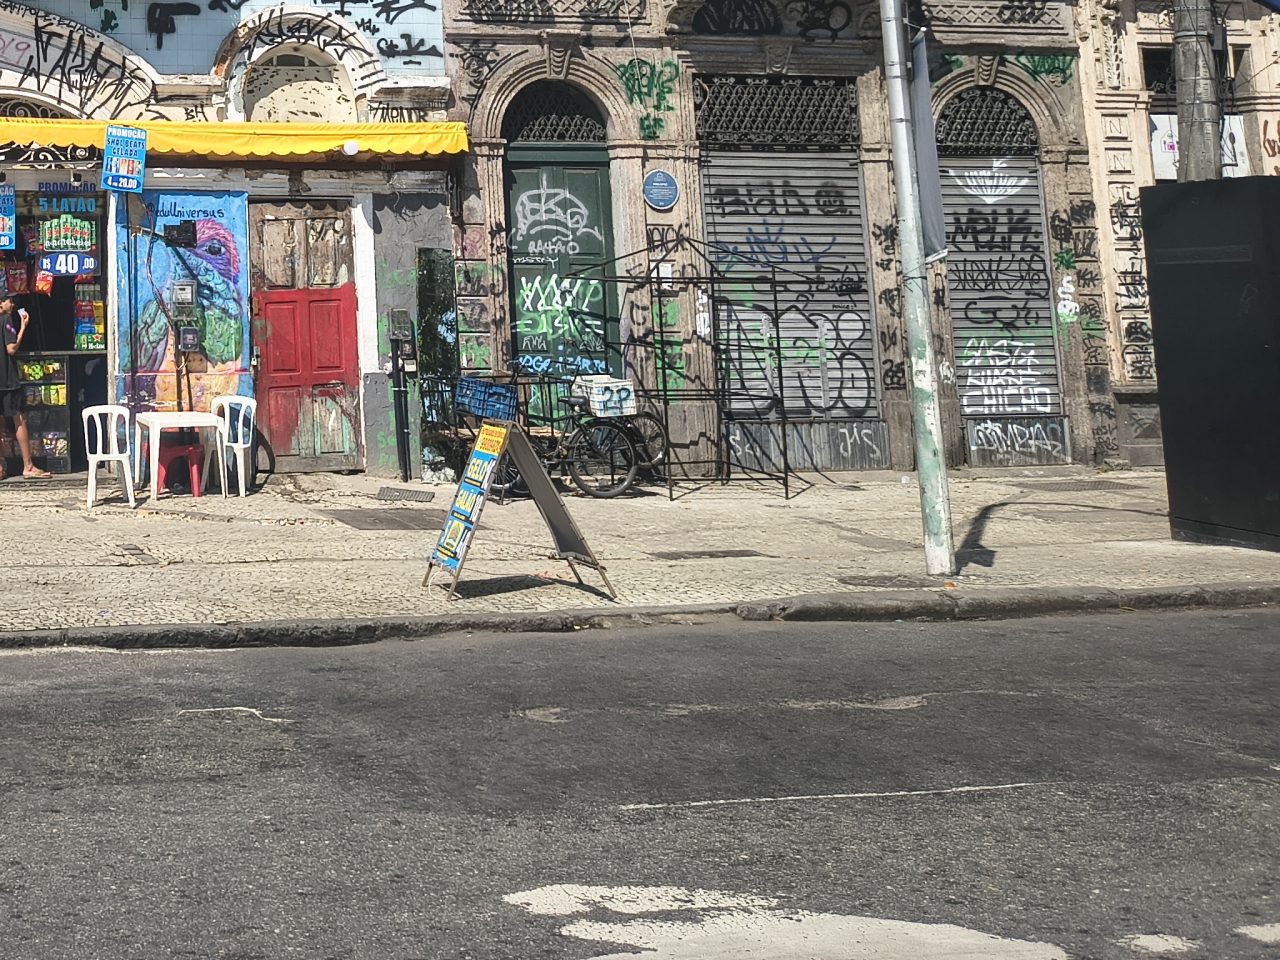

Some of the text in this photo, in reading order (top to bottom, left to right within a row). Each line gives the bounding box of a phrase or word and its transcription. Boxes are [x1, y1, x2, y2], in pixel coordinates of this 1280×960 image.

[107, 127, 146, 139] PROMOÇÃO
[107, 138, 145, 149] SKOL BEATS
[113, 148, 138, 157] GELADA
[40, 197, 96, 212] 5 LATÃO
[43, 258, 51, 270] R$
